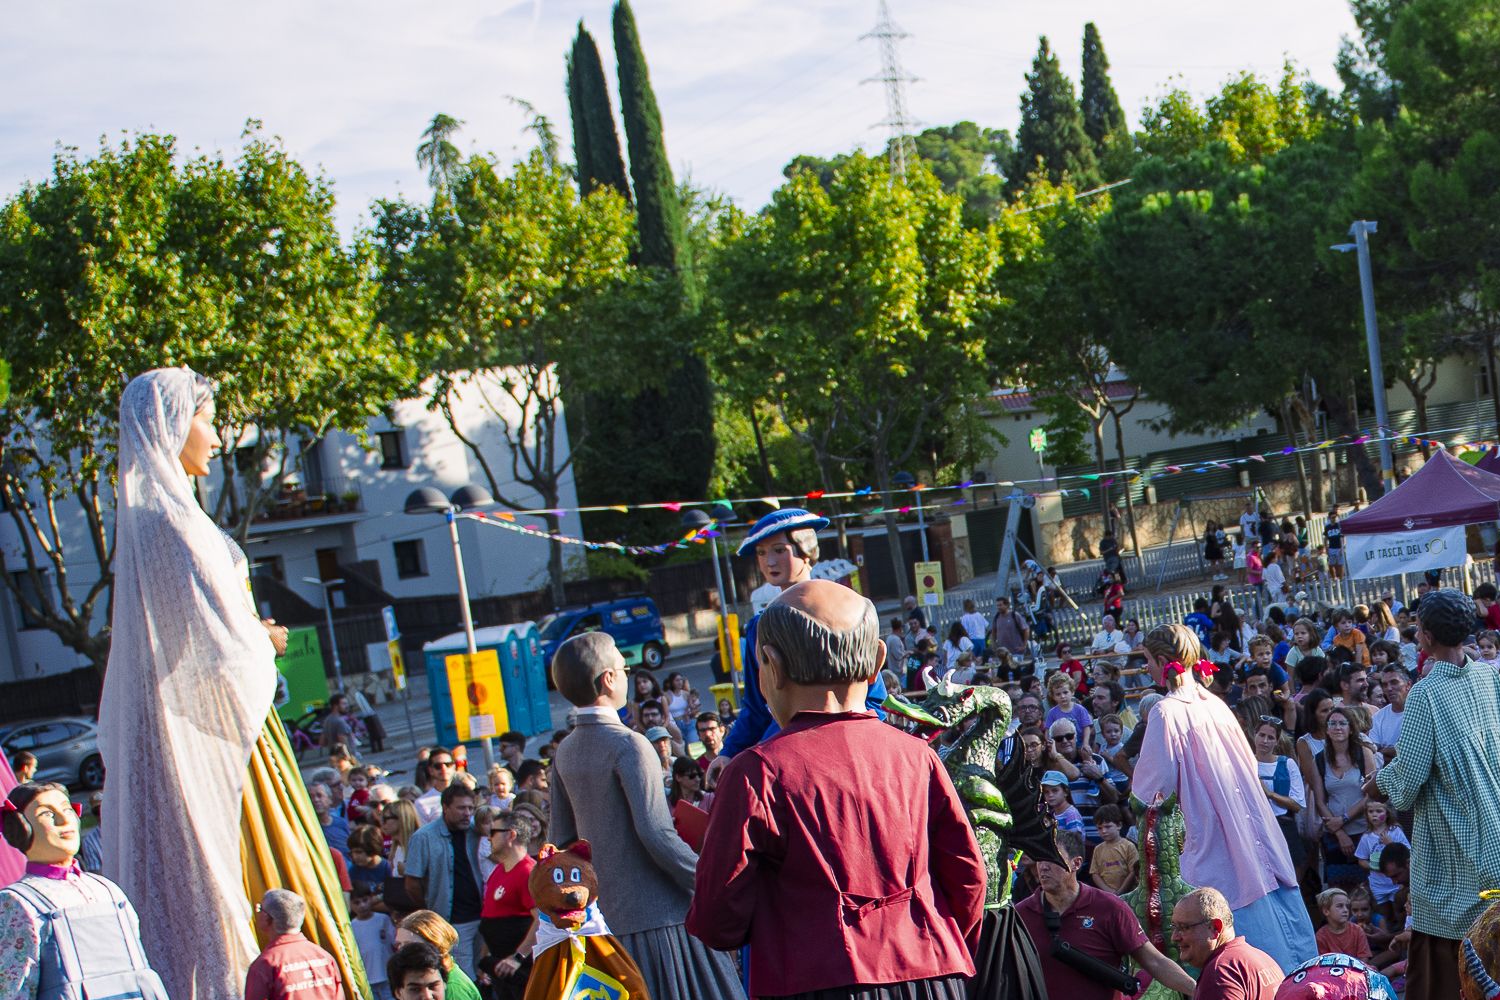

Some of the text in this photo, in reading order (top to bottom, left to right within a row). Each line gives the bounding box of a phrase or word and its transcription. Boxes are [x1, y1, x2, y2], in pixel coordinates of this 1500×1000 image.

[1365, 550, 1376, 561] LA
[1378, 546, 1404, 558] TASCA
[1406, 543, 1422, 555] DEL
[1424, 538, 1448, 555] SOL
